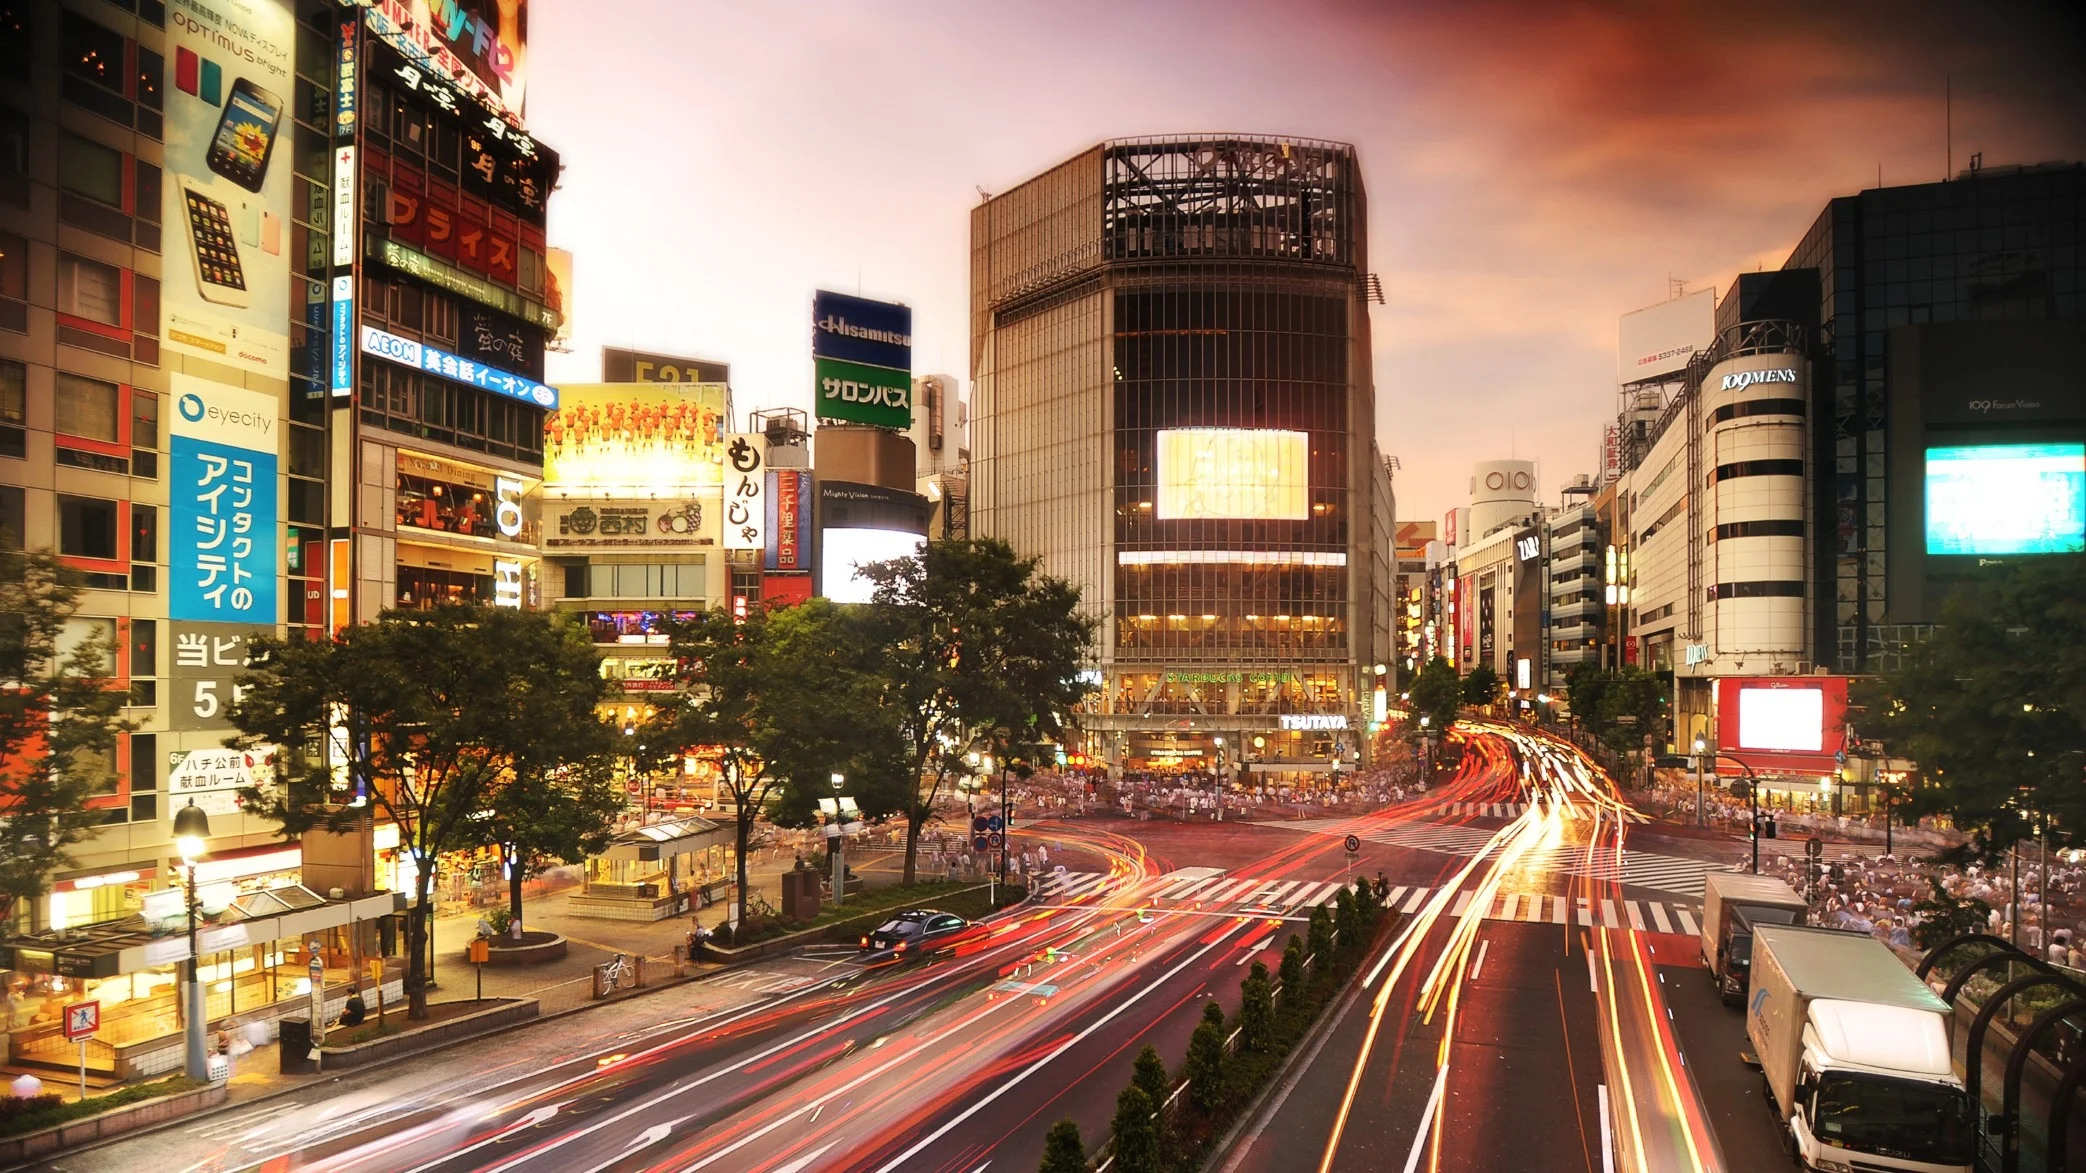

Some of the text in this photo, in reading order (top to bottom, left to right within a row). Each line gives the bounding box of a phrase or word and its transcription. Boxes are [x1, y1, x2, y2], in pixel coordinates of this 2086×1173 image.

[256, 56, 287, 77] bright
[471, 139, 483, 152] 9F
[391, 193, 513, 272] プライス
[818, 315, 911, 347] Hisamitsu
[368, 331, 416, 363] AEON
[239, 351, 267, 365] docomo
[425, 348, 530, 396] 英会話イーオン
[822, 376, 909, 409] サロンパス
[1969, 400, 2040, 414] 109 Forum Vision
[208, 404, 271, 434] eyecity
[447, 465, 476, 482] Dining
[728, 437, 761, 543] もんじゃ
[824, 489, 847, 499] Mighty
[600, 516, 648, 535] 西村
[780, 473, 794, 563] 三千里薬品
[197, 453, 228, 609] アイシティ
[232, 460, 253, 610] コンタクトの
[1167, 673, 1243, 683] STARBUCKS
[1281, 715, 1348, 730] TSUTAYA
[186, 756, 241, 771] ハチ公前
[180, 777, 245, 789] 献血ルーム
